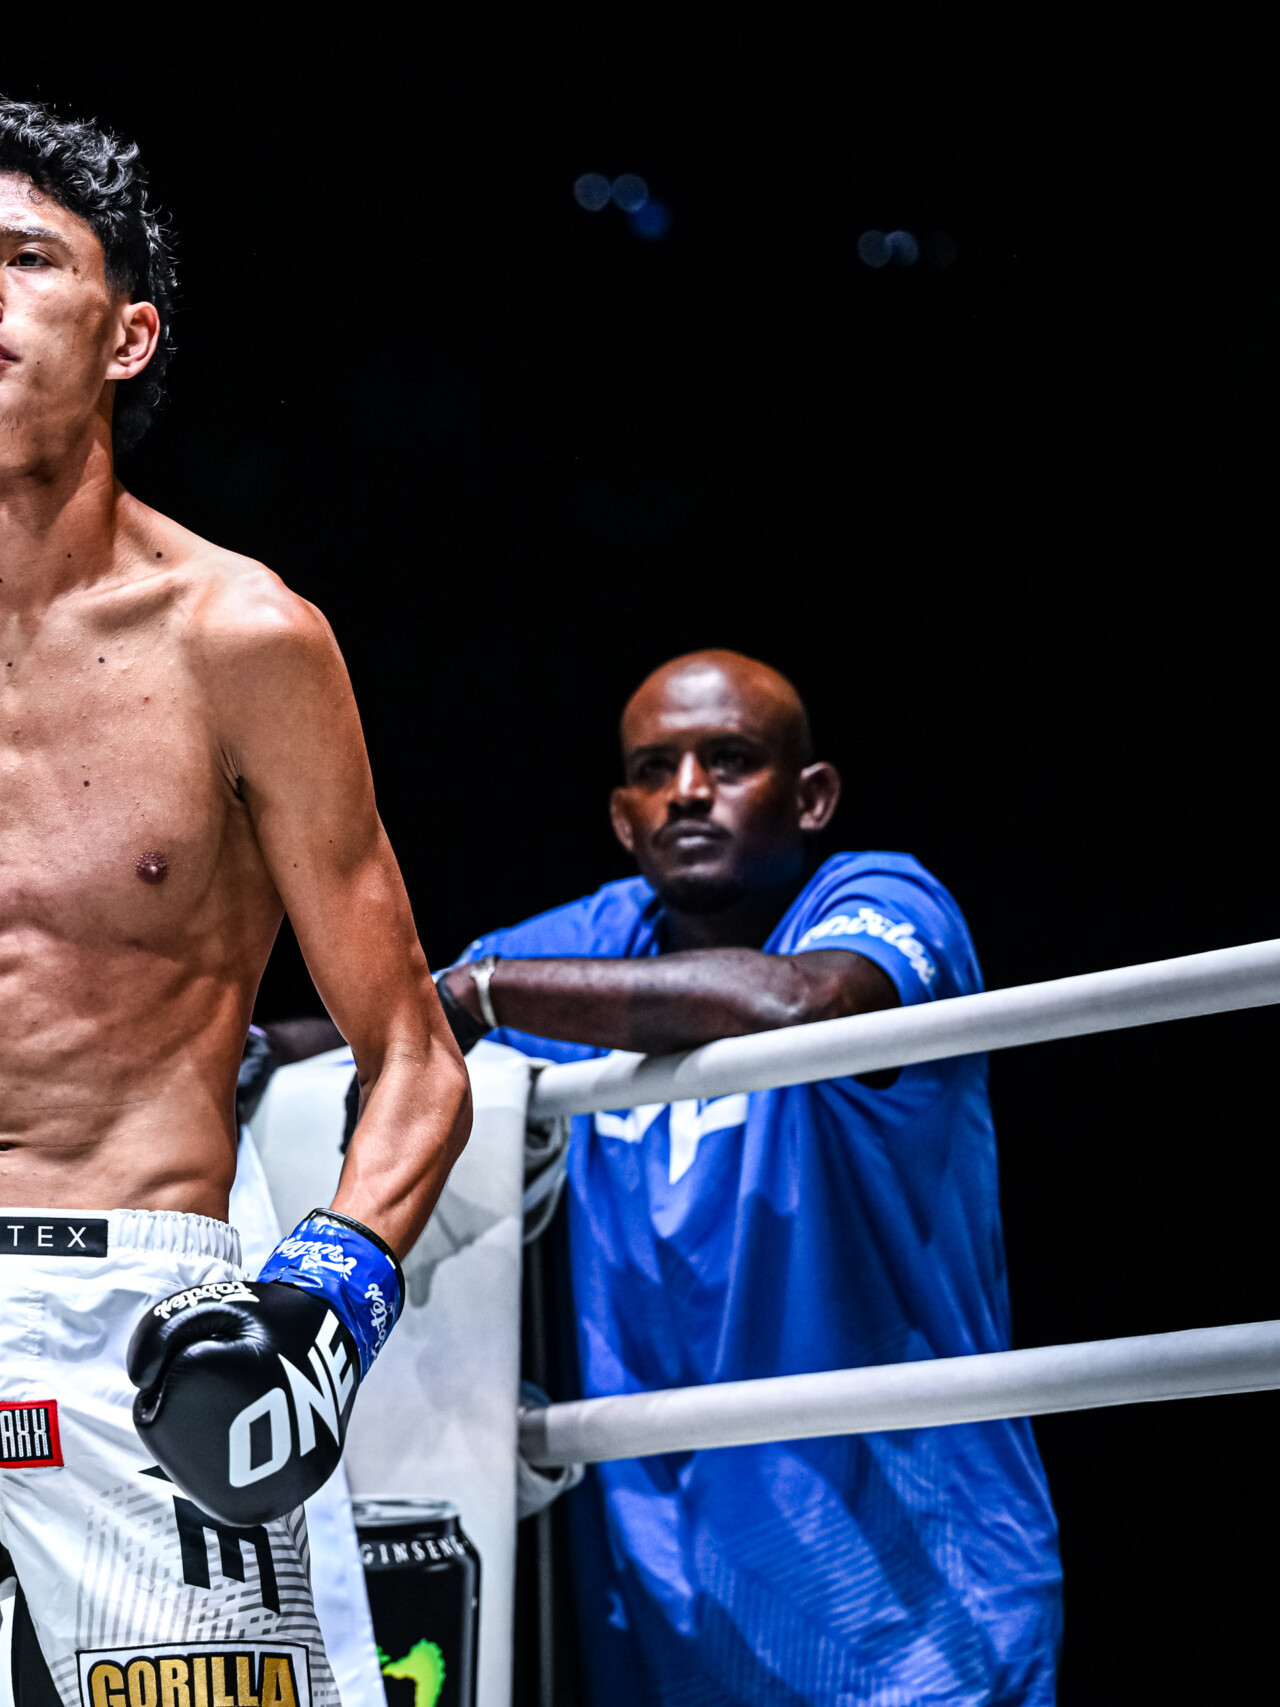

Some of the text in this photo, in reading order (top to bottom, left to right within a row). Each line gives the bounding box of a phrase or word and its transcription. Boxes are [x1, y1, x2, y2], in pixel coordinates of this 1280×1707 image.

[229, 1309, 355, 1488] ONE
[360, 1535, 466, 1566] GINSENG
[87, 1652, 301, 1707] GORILLA
